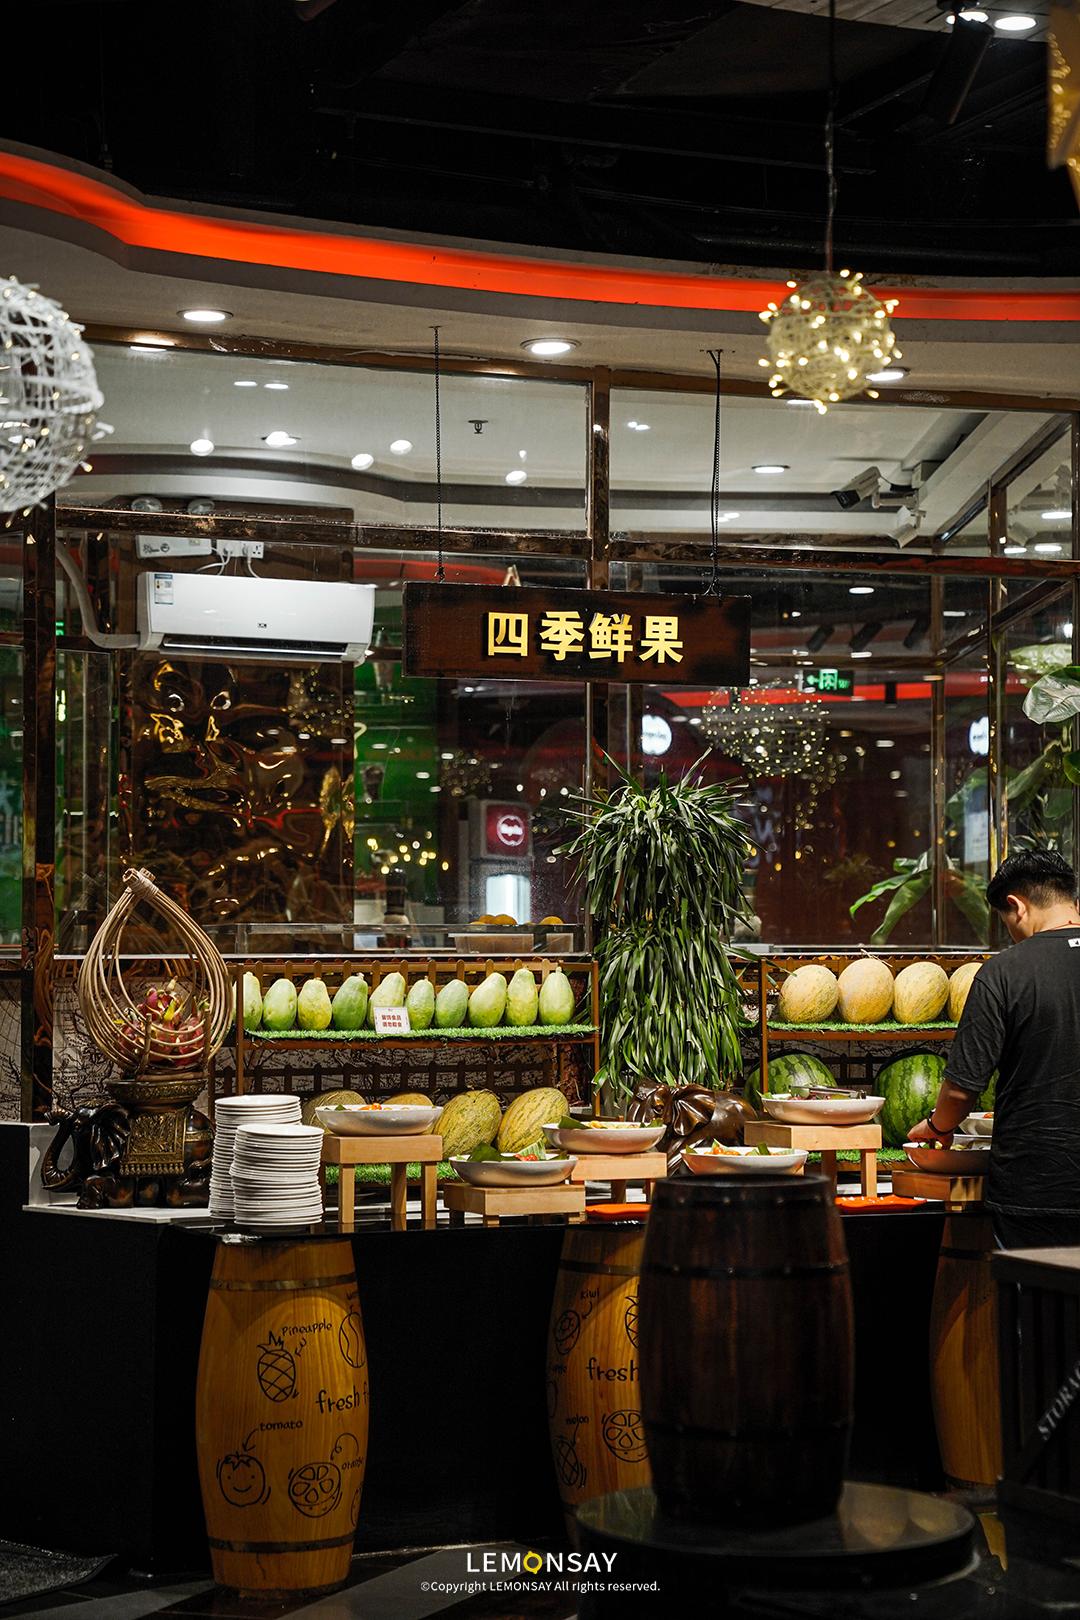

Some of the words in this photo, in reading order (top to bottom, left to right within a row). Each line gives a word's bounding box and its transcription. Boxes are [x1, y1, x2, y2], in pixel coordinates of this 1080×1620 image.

[487, 611, 684, 664] 四季鲜果
[586, 1356, 640, 1382] fresh
[315, 1384, 361, 1414] fresh
[259, 1419, 304, 1432] tomato
